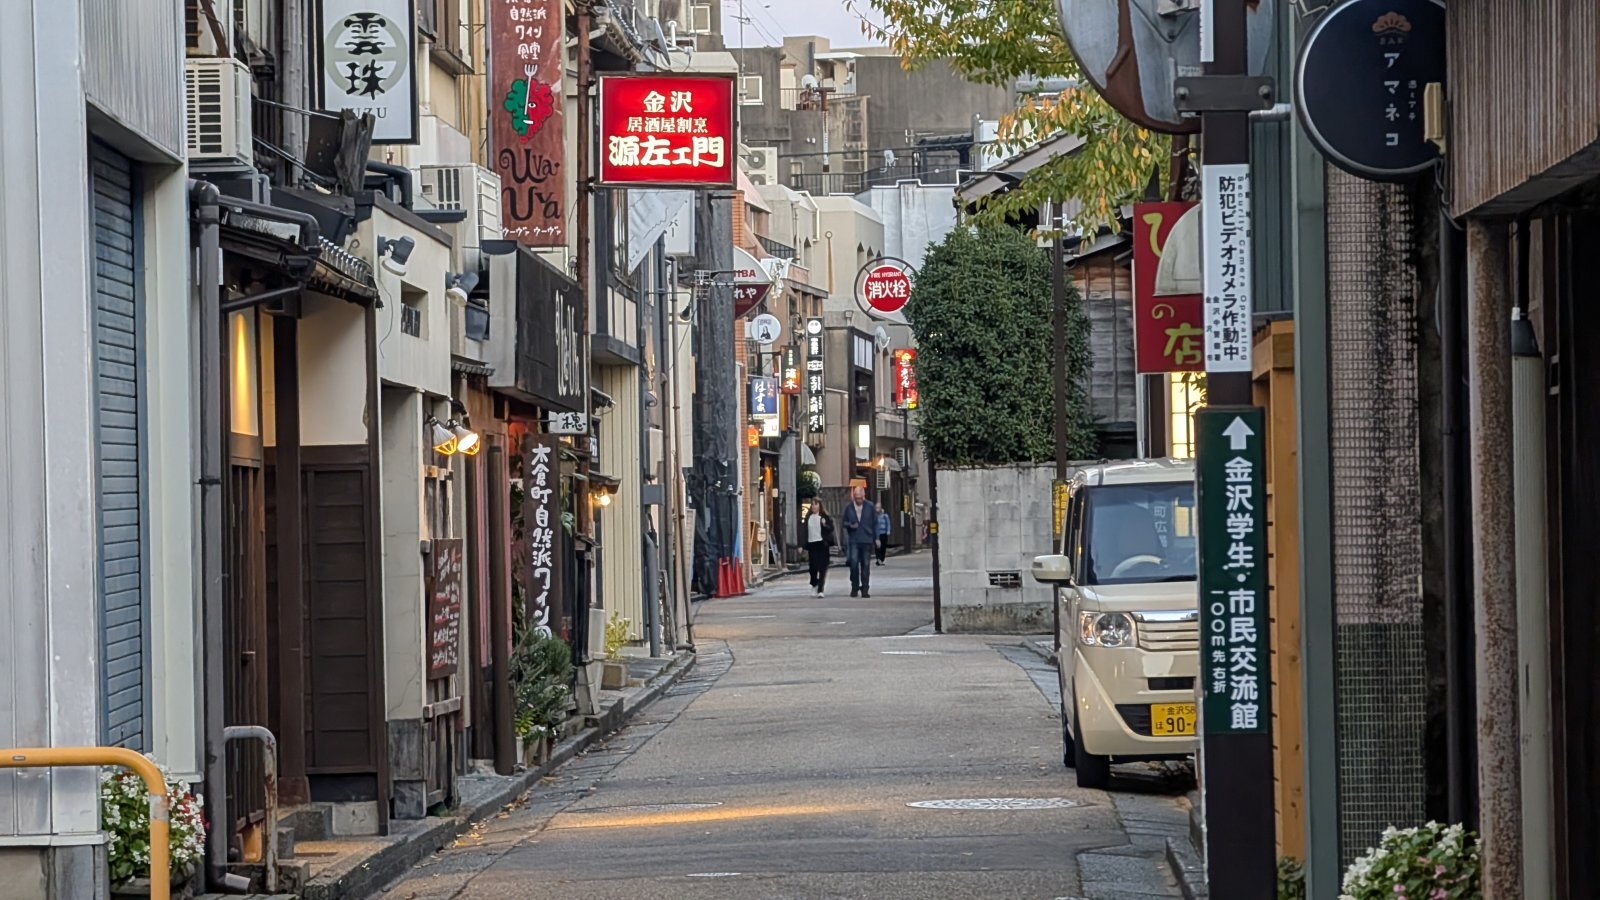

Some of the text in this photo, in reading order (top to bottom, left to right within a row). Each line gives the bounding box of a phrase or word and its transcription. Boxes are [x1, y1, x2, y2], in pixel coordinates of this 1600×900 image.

[515, 25, 542, 40] ワイン
[518, 41, 541, 60] 食堂
[643, 90, 693, 113] 金沢
[1384, 52, 1400, 146] アマネコ
[627, 116, 708, 133] 居酒屋割烹
[608, 134, 724, 168] 源左エ門
[501, 186, 560, 221] Uva
[1236, 176, 1245, 231] Security
[1219, 175, 1239, 361] 防犯ビデオカメラ作動中
[868, 280, 907, 299] 消火栓
[1240, 294, 1248, 360] Operating
[1224, 456, 1259, 729] 金沢学生・市民交流館
